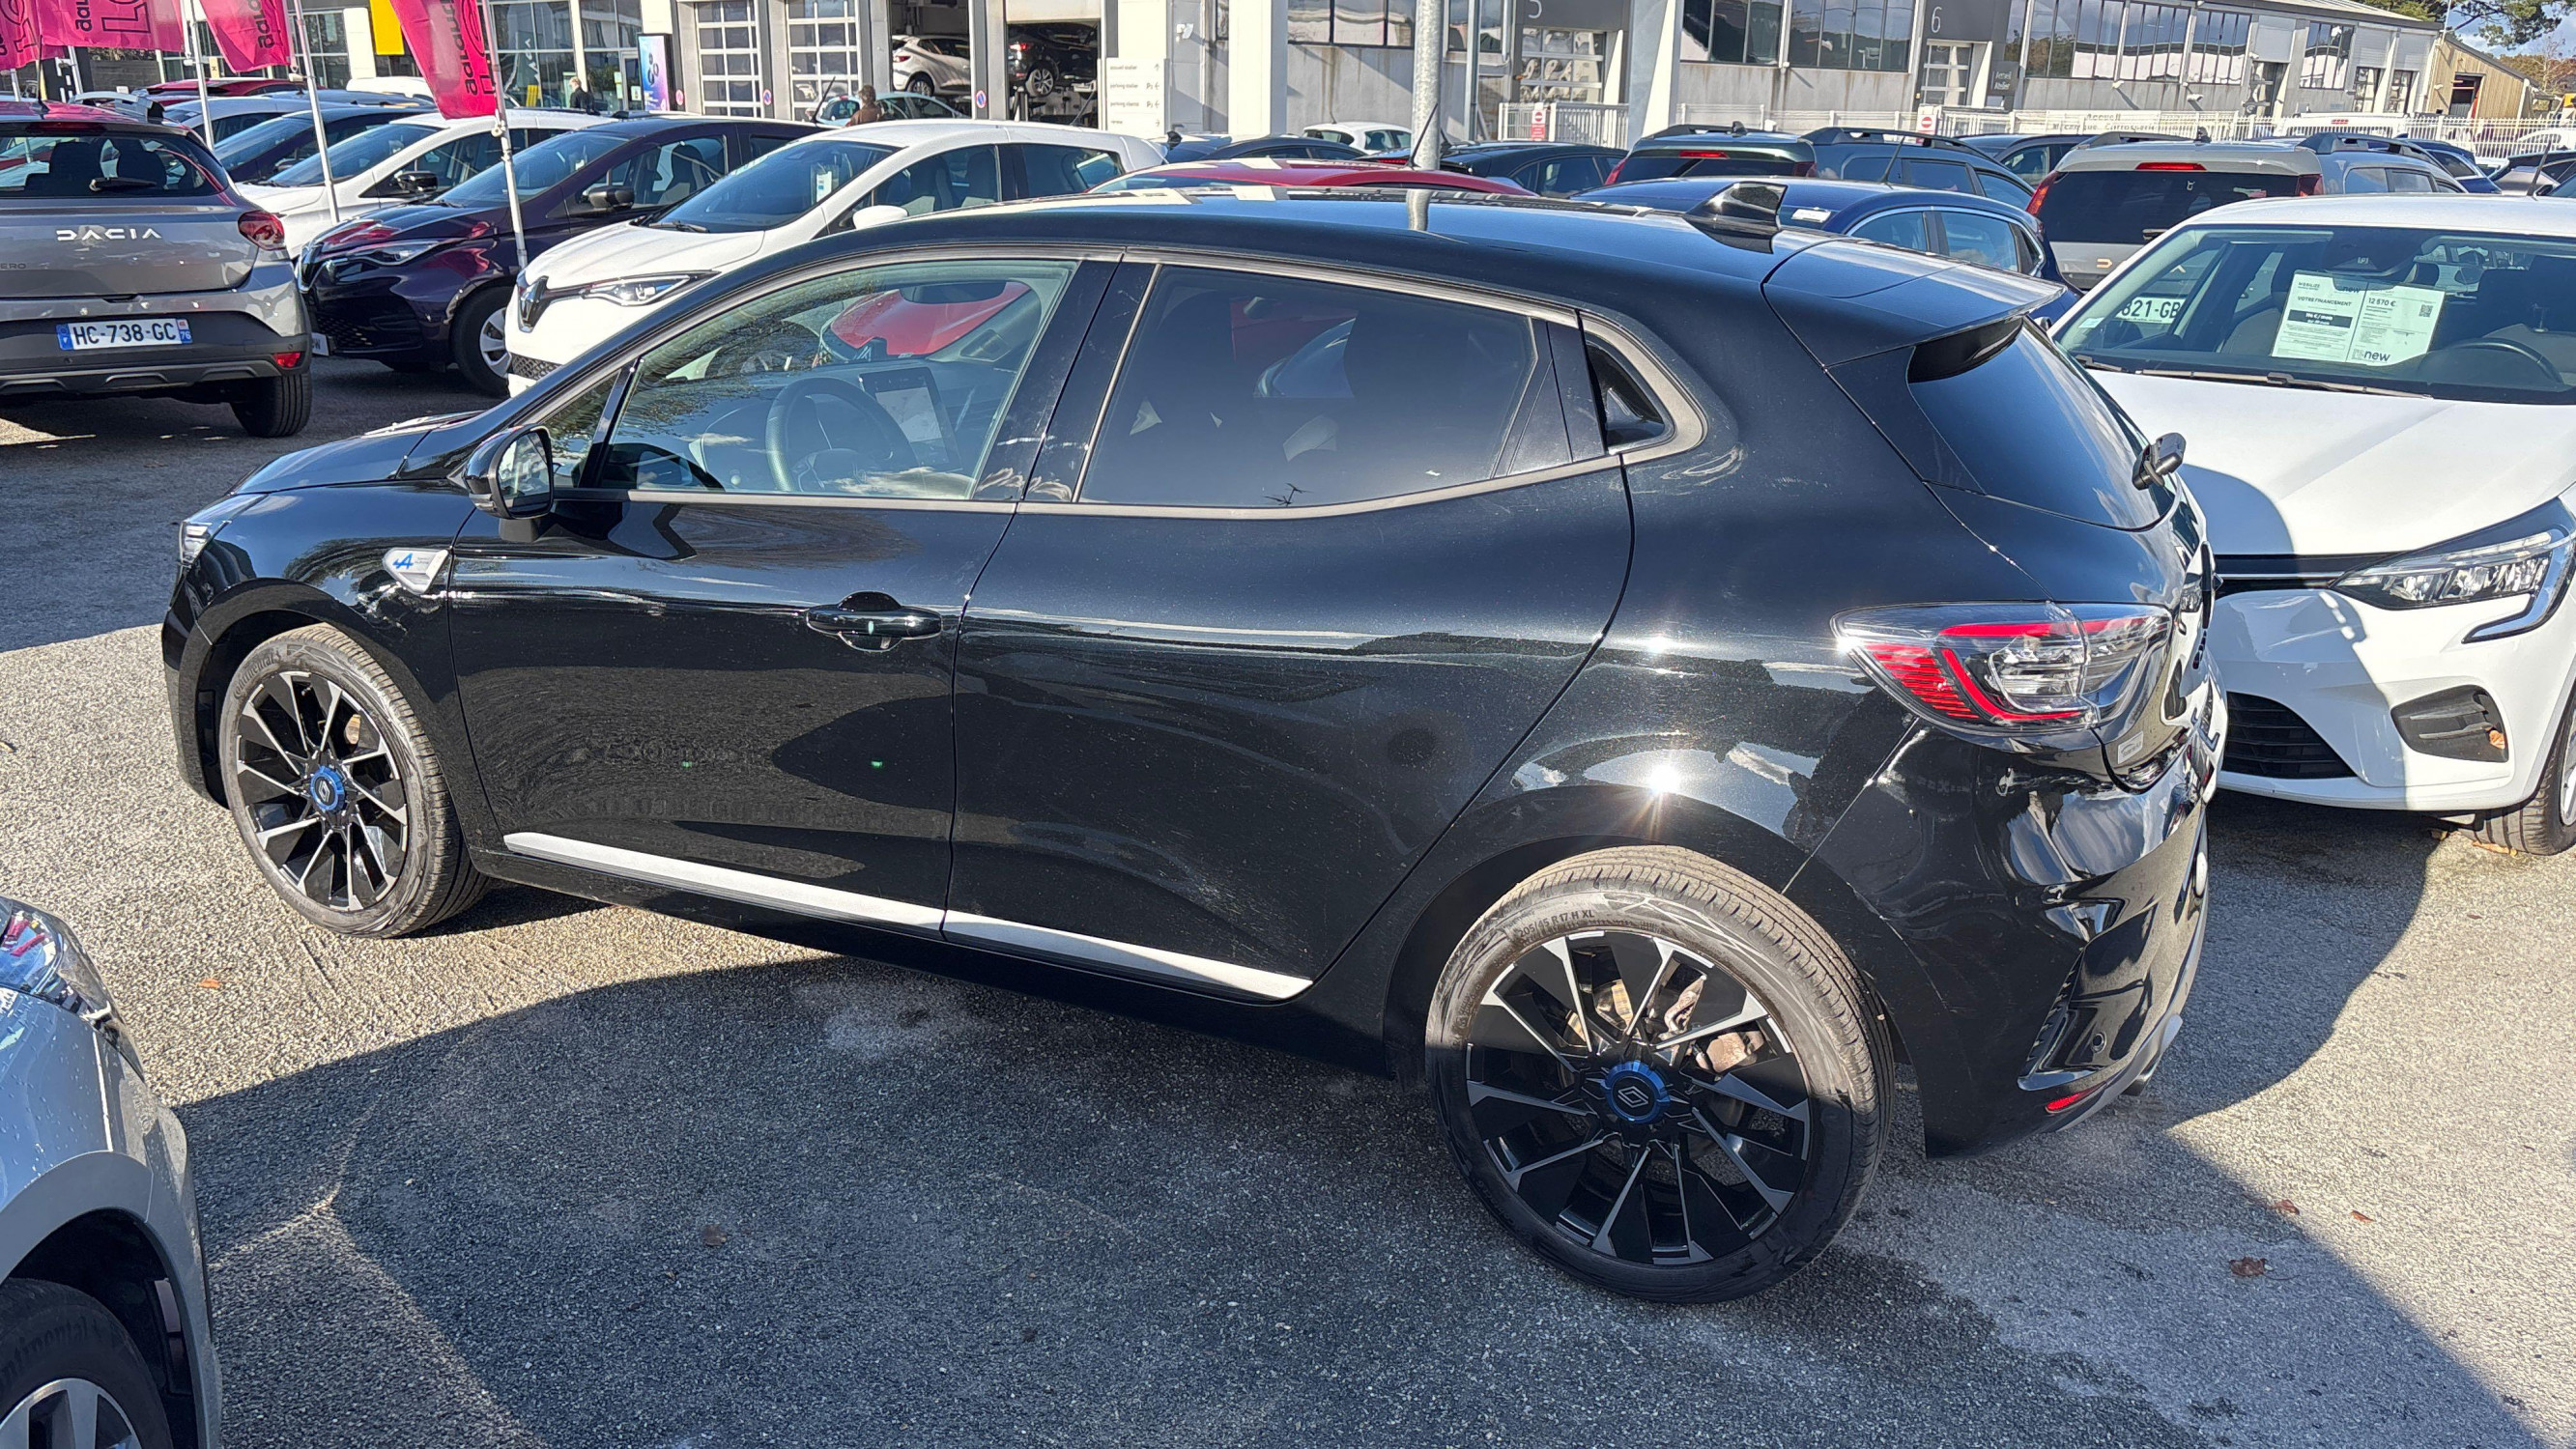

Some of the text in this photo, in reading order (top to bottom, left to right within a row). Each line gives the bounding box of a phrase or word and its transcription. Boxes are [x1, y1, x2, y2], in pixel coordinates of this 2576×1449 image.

[1931, 6, 1942, 33] 6
[56, 228, 162, 242] DACIA
[2314, 298, 2352, 306] FINANCEMENT
[72, 323, 191, 346] HC-738-GC 76
[1519, 918, 1550, 938] 205/45
[1581, 909, 1595, 919] XL
